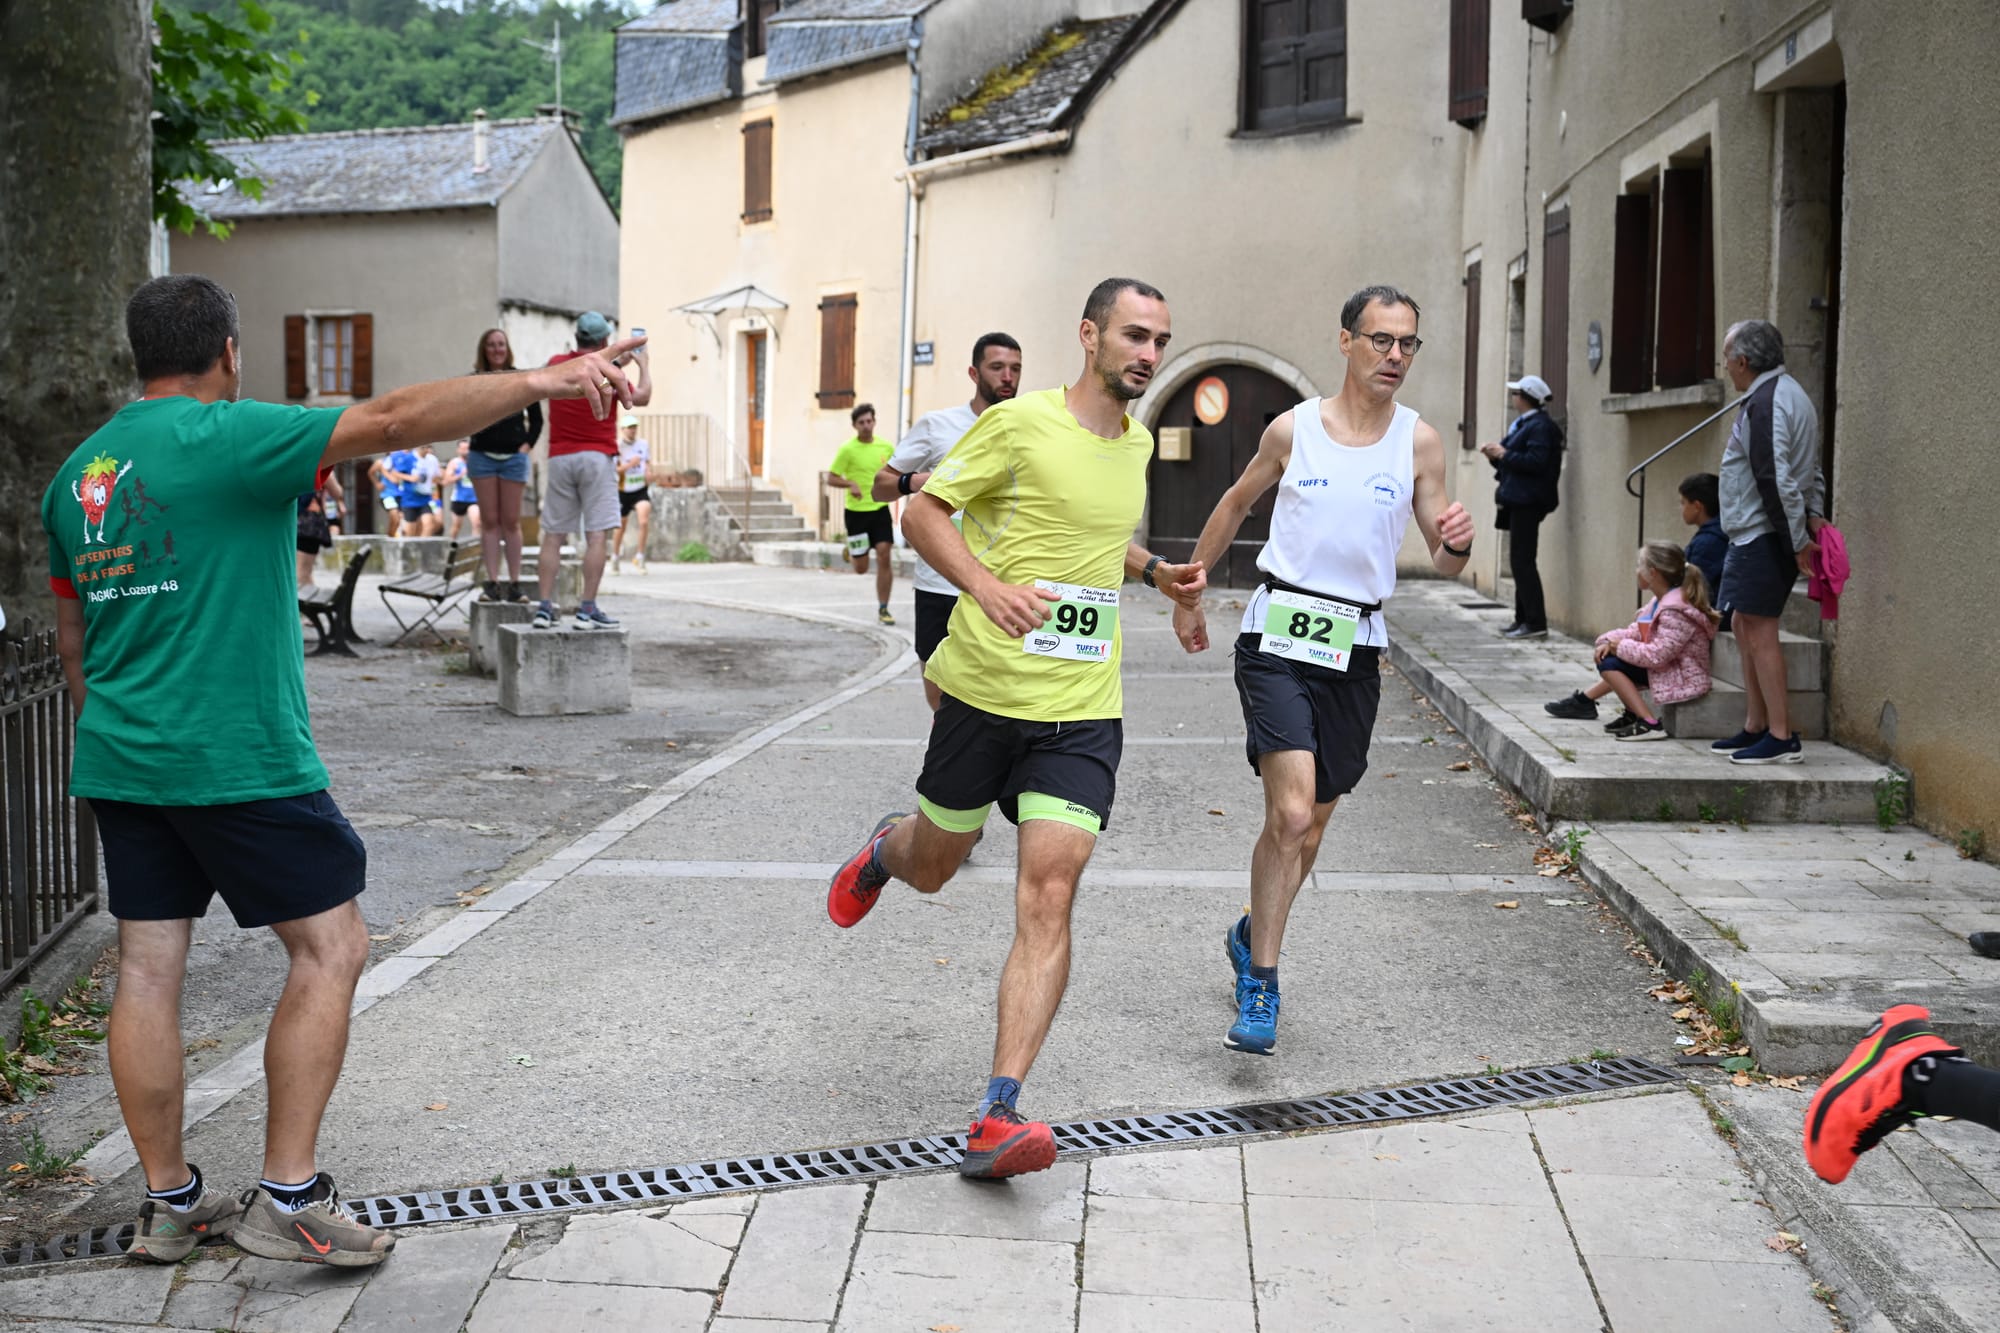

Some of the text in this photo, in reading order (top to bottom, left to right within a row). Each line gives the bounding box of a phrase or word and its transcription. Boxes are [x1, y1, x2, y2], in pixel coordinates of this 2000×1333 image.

[1298, 479, 1328, 487] TUFF'S
[160, 580, 179, 591] 48
[1056, 604, 1098, 636] 99
[1289, 612, 1333, 644] 82
[1034, 638, 1057, 647] BFP
[1066, 804, 1085, 815] NIKE
